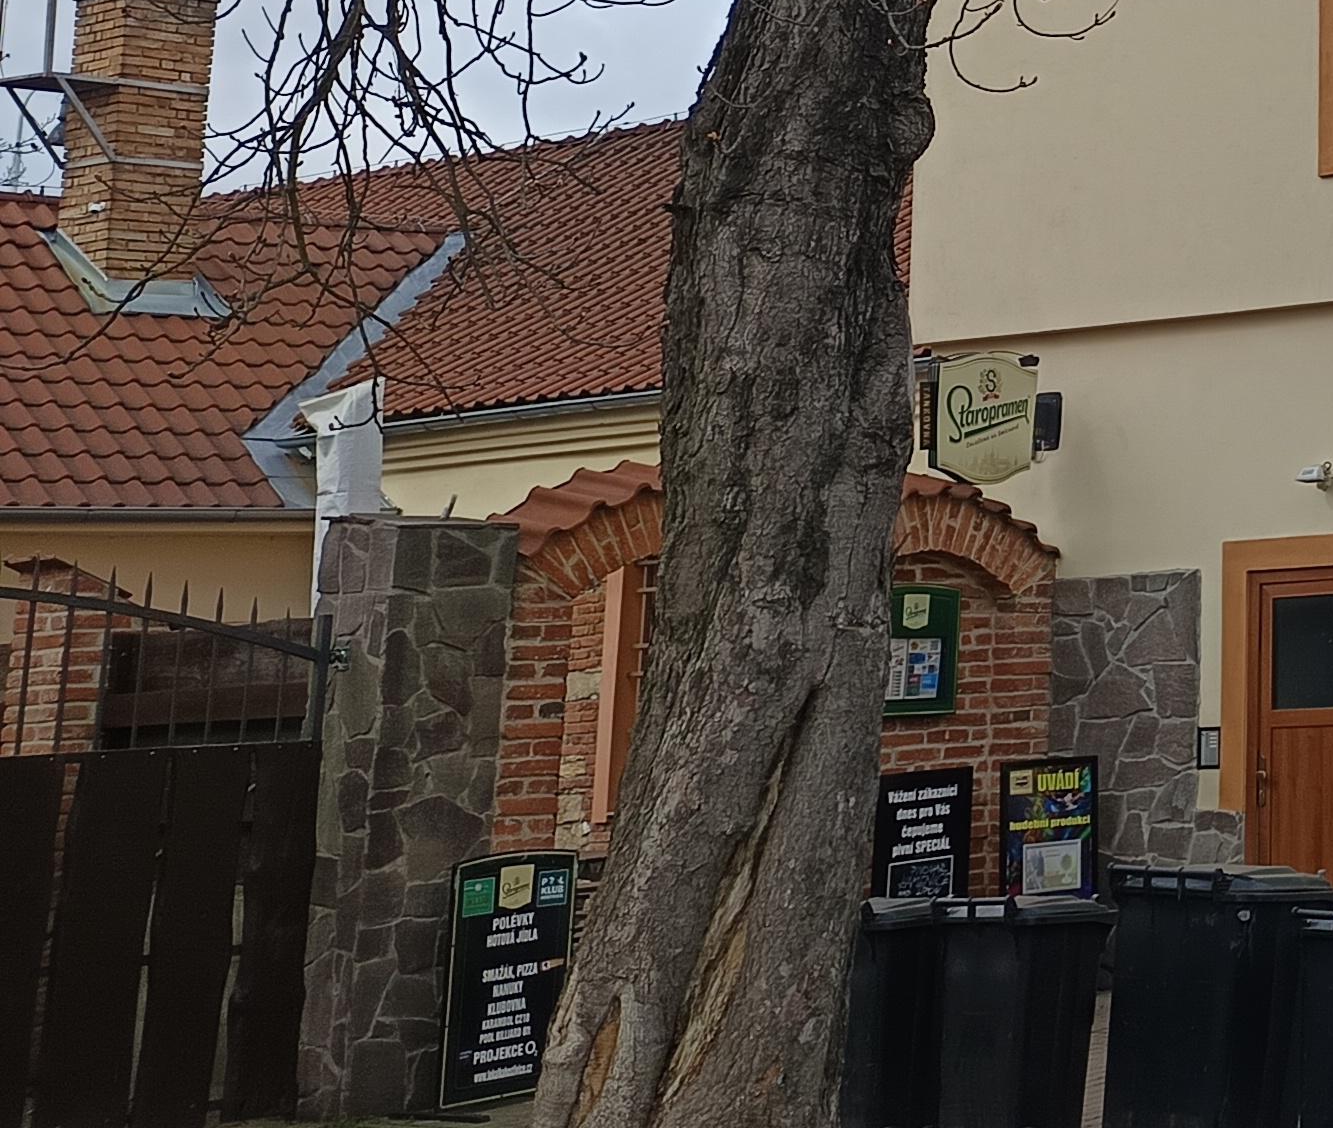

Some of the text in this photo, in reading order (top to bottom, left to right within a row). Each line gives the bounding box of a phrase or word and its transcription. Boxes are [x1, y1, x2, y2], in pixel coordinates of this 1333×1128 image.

[922, 384, 931, 447] TANKOVNA
[946, 385, 1030, 443] Staropramen
[1037, 768, 1080, 792] UVÁDÍ
[888, 783, 958, 804] Vážení zákazníci
[896, 802, 951, 820] dnes pro Vás
[901, 823, 944, 838] čepujeme
[1009, 814, 1091, 831] hudební produkci
[892, 834, 952, 858] pivní SPECIÁL
[540, 885, 565, 895] KLUB
[492, 912, 535, 931] POLÉVKY
[486, 927, 538, 948] HOTOVÁ JÍDLA
[517, 962, 539, 977] PIZZA
[487, 997, 527, 1016] KLUBOVNA
[473, 1043, 524, 1065] PROJEKCE
